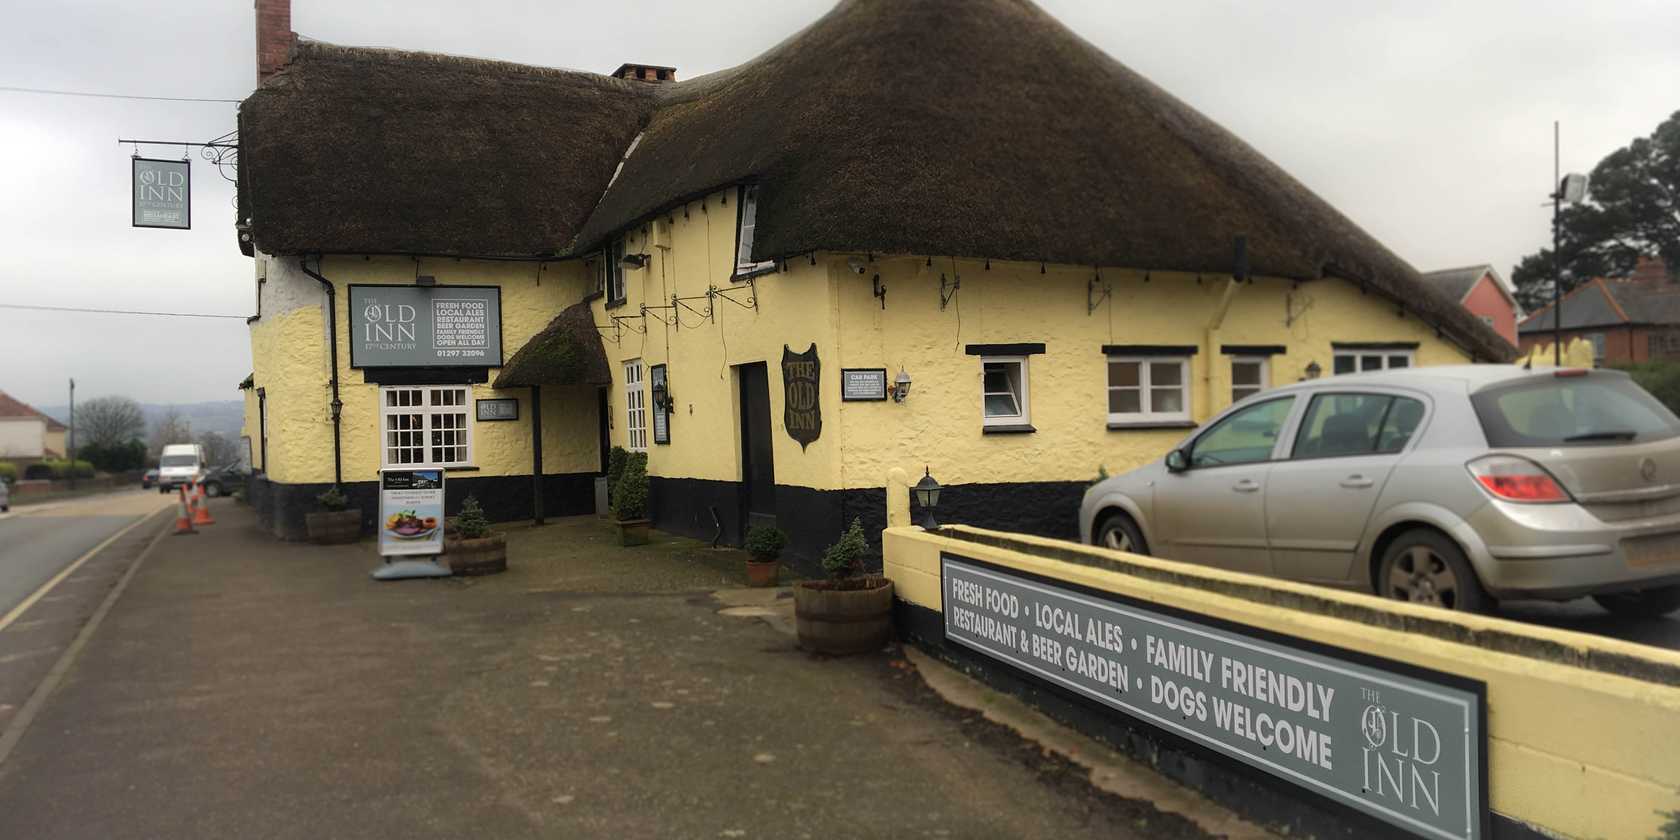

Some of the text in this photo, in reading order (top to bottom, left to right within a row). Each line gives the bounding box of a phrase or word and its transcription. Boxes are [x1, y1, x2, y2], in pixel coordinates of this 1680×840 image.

[139, 170, 184, 186] OLD
[139, 184, 184, 202] INN
[364, 304, 416, 323] OLD
[364, 323, 416, 341] INN
[380, 343, 417, 351] CENTURY
[785, 361, 815, 379] THE
[788, 381, 816, 410] OLD
[789, 408, 816, 430] INN
[953, 577, 1335, 722] FRESH FOOD LOCAL ALES FAMILY FRIENDLY
[953, 606, 1333, 770] RESTAURANT & BEER GARDEN DOGS WELCOME
[1360, 687, 1381, 705] THE
[1361, 704, 1441, 765] OLD
[1362, 746, 1440, 817] INN
